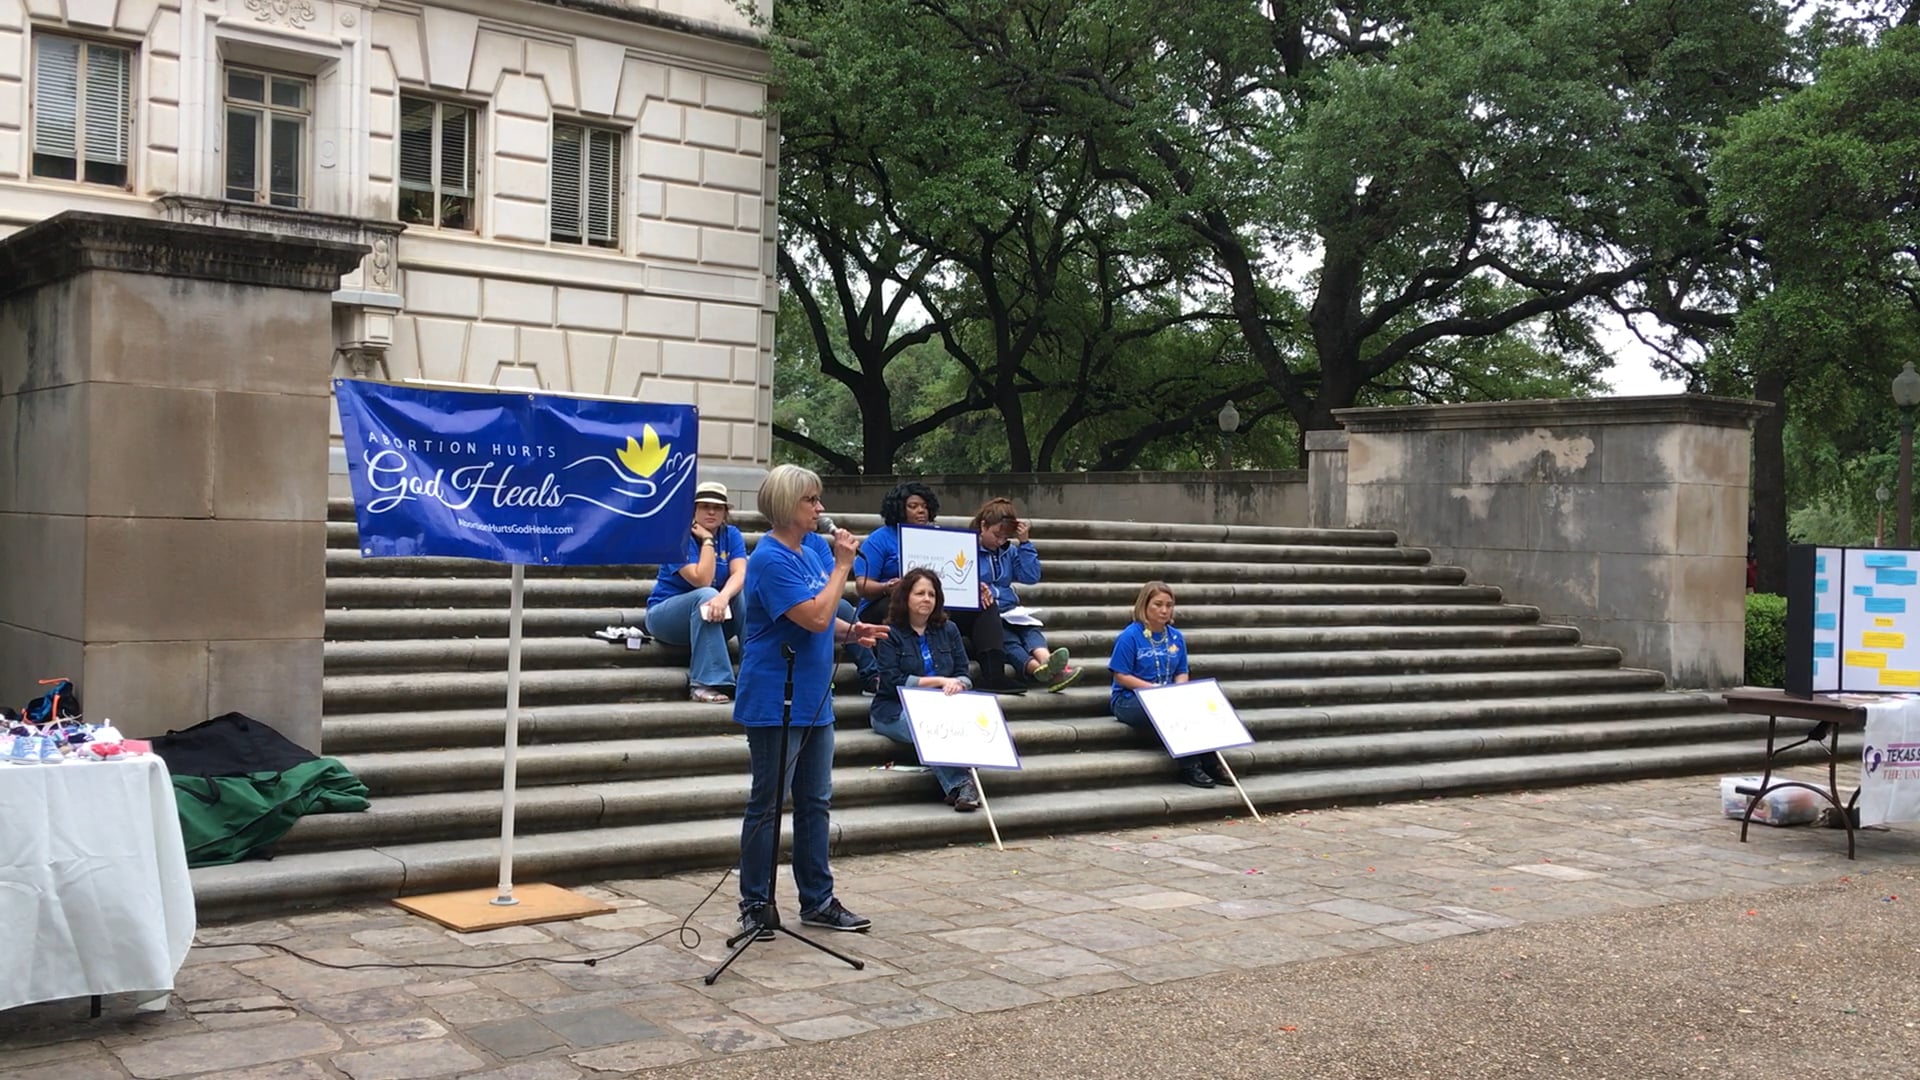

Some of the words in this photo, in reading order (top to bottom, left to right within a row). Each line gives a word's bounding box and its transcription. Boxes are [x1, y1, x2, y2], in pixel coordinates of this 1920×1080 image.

[368, 431, 478, 454] ABORTION
[492, 443, 557, 459] HURTS
[363, 448, 446, 514] God
[444, 461, 563, 511] Heals
[457, 517, 574, 535] AbortionHurtsGodHeals.com
[1887, 749, 1915, 762] TEXAS
